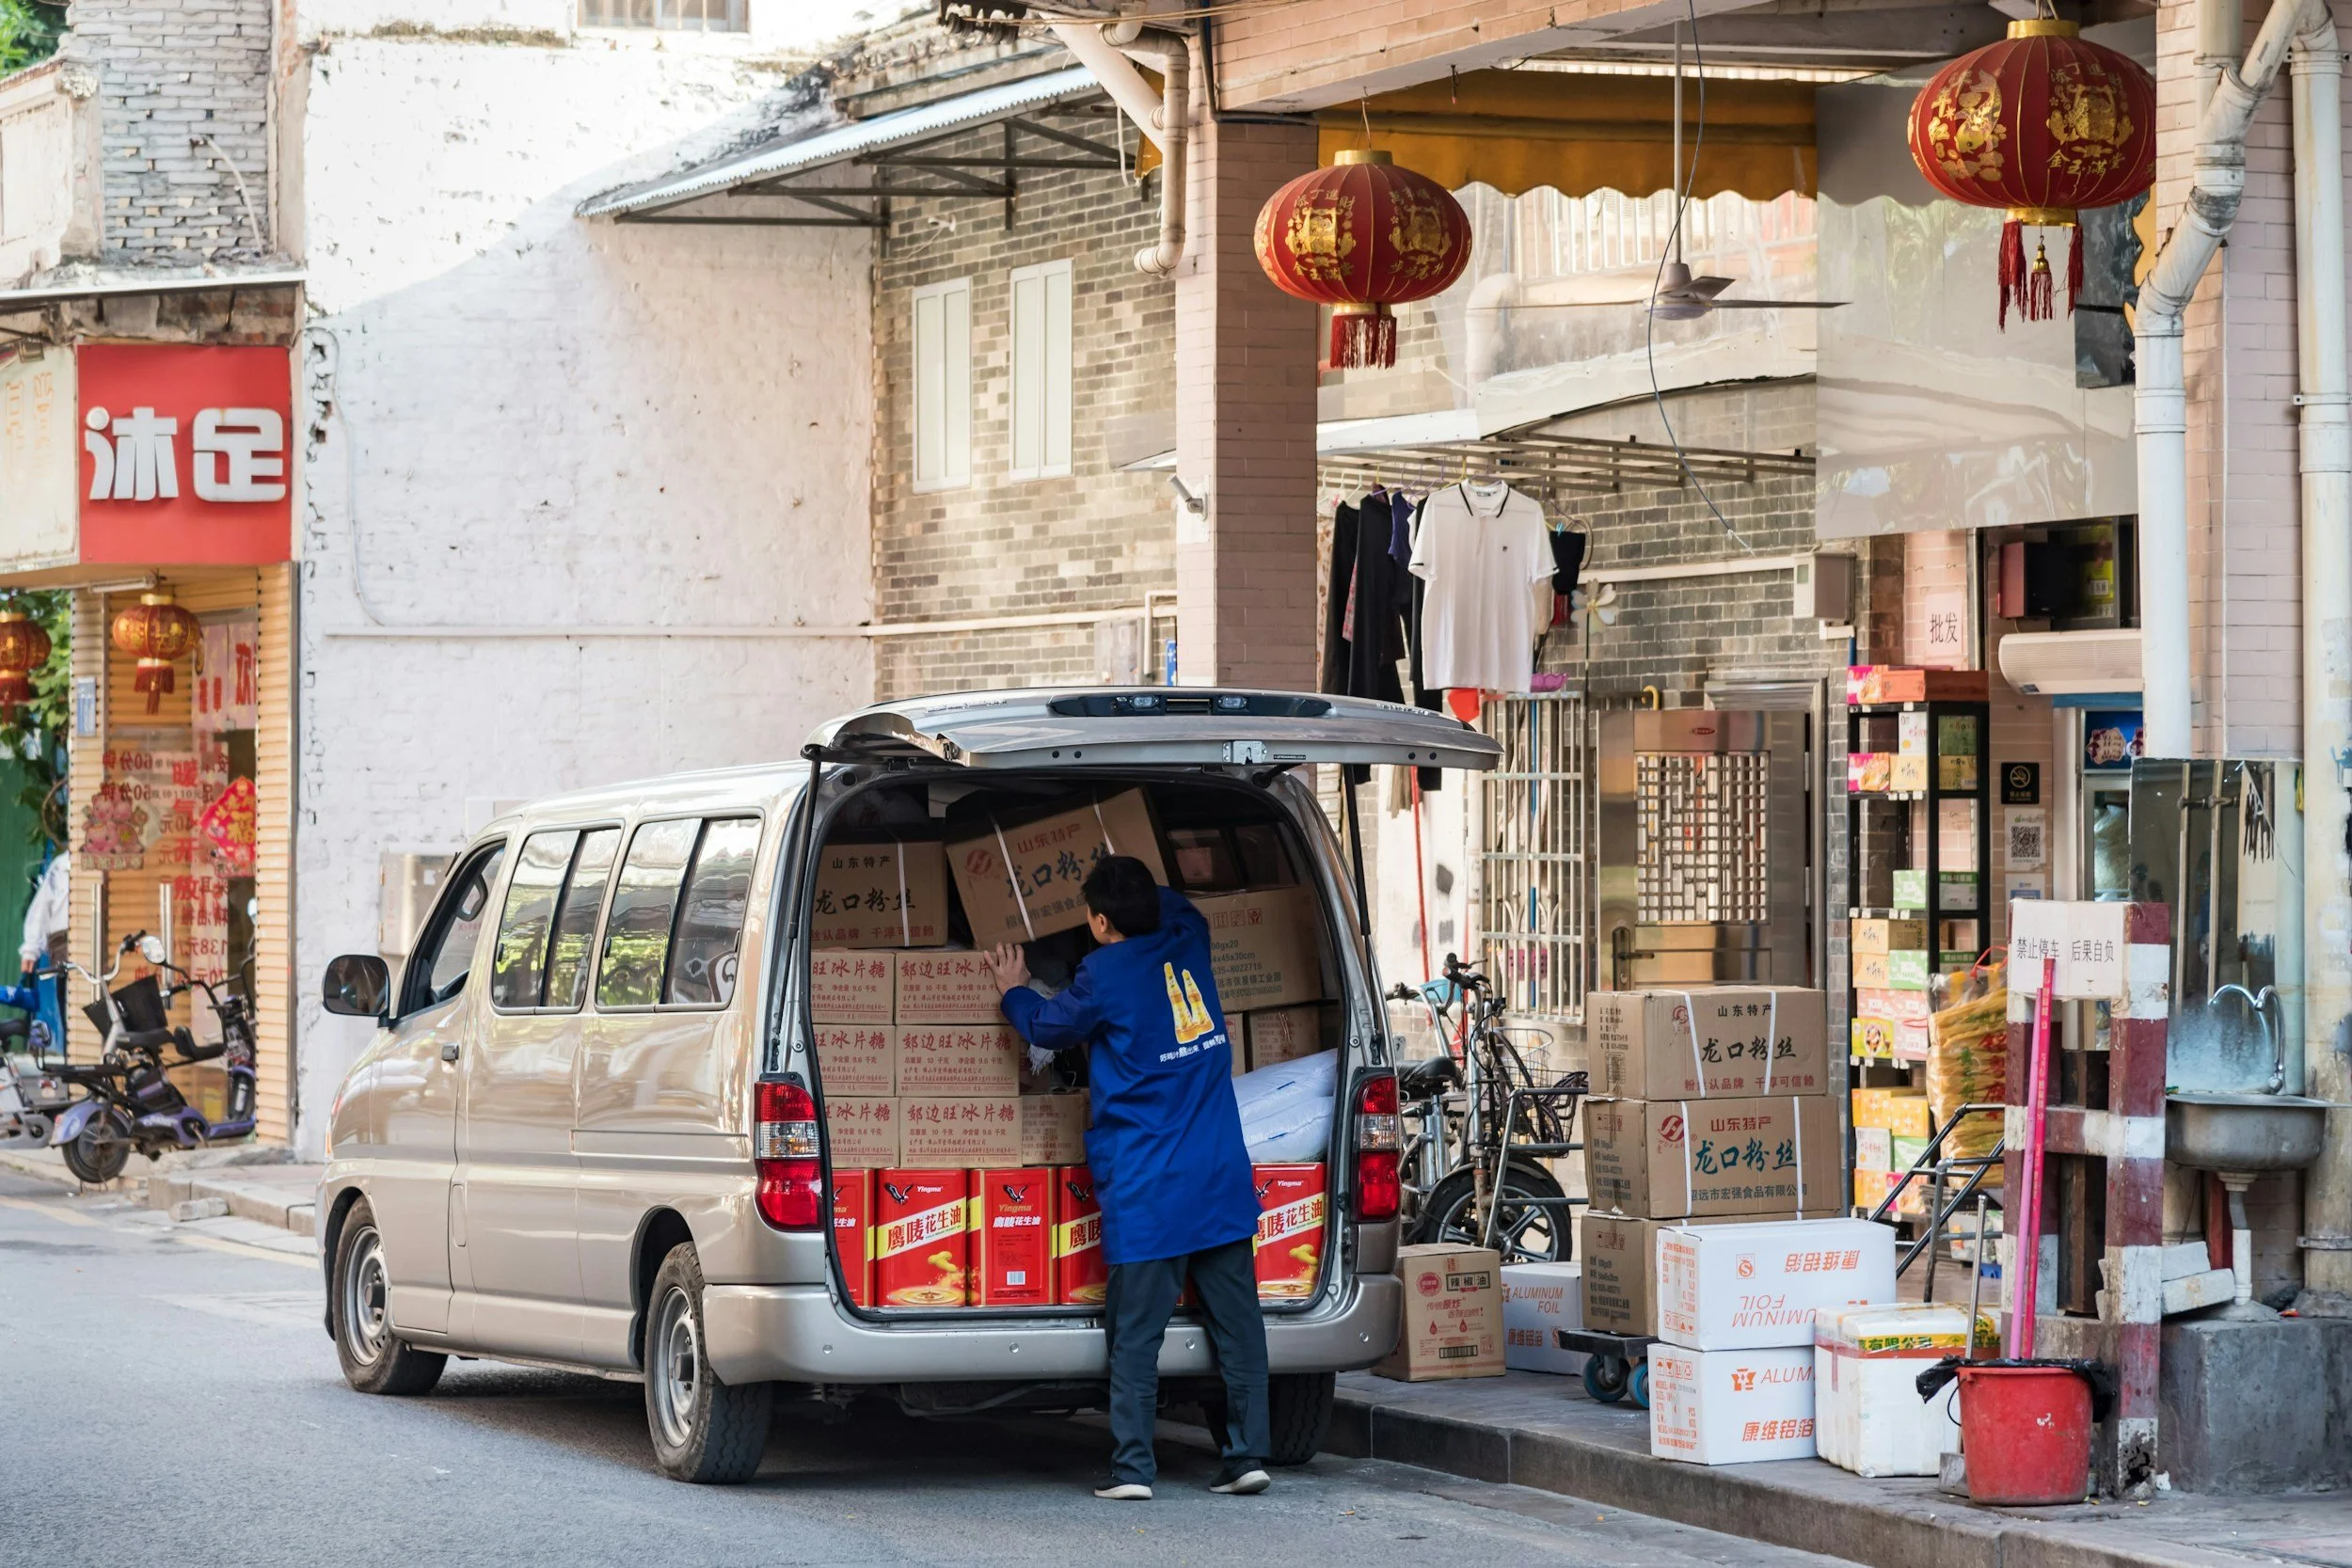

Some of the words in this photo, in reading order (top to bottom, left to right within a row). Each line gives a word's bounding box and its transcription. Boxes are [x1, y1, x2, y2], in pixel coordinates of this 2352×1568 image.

[85, 405, 287, 502] 沐足
[1930, 611, 1959, 645] 批发
[1017, 823, 1081, 854] 山东特产
[832, 855, 891, 869] 山东特产
[815, 886, 916, 915] 龙口粉丝
[2016, 938, 2060, 960] 禁止停车
[2071, 940, 2115, 964] 后果自负
[1718, 1004, 1772, 1018] 山东特产
[1702, 1036, 1797, 1063] 龙口粉丝
[1710, 1117, 1772, 1132] 山东特产
[1694, 1137, 1799, 1175] 龙口粉丝
[916, 1184, 942, 1194] Yingma
[1277, 1180, 1302, 1188] Yingma
[998, 1203, 1033, 1213] Yingma
[887, 1205, 961, 1252] 鹰唛花生油
[1785, 1250, 1861, 1273] 康维铝箔
[1450, 1275, 1486, 1289] 辣椒油
[1512, 1286, 1564, 1300] ALUMINUM
[1740, 1293, 1787, 1311] FOIL
[1537, 1301, 1561, 1314] FOIL
[1507, 1328, 1543, 1347] 康维铝箔
[1742, 1418, 1815, 1442] 康维铝箔
